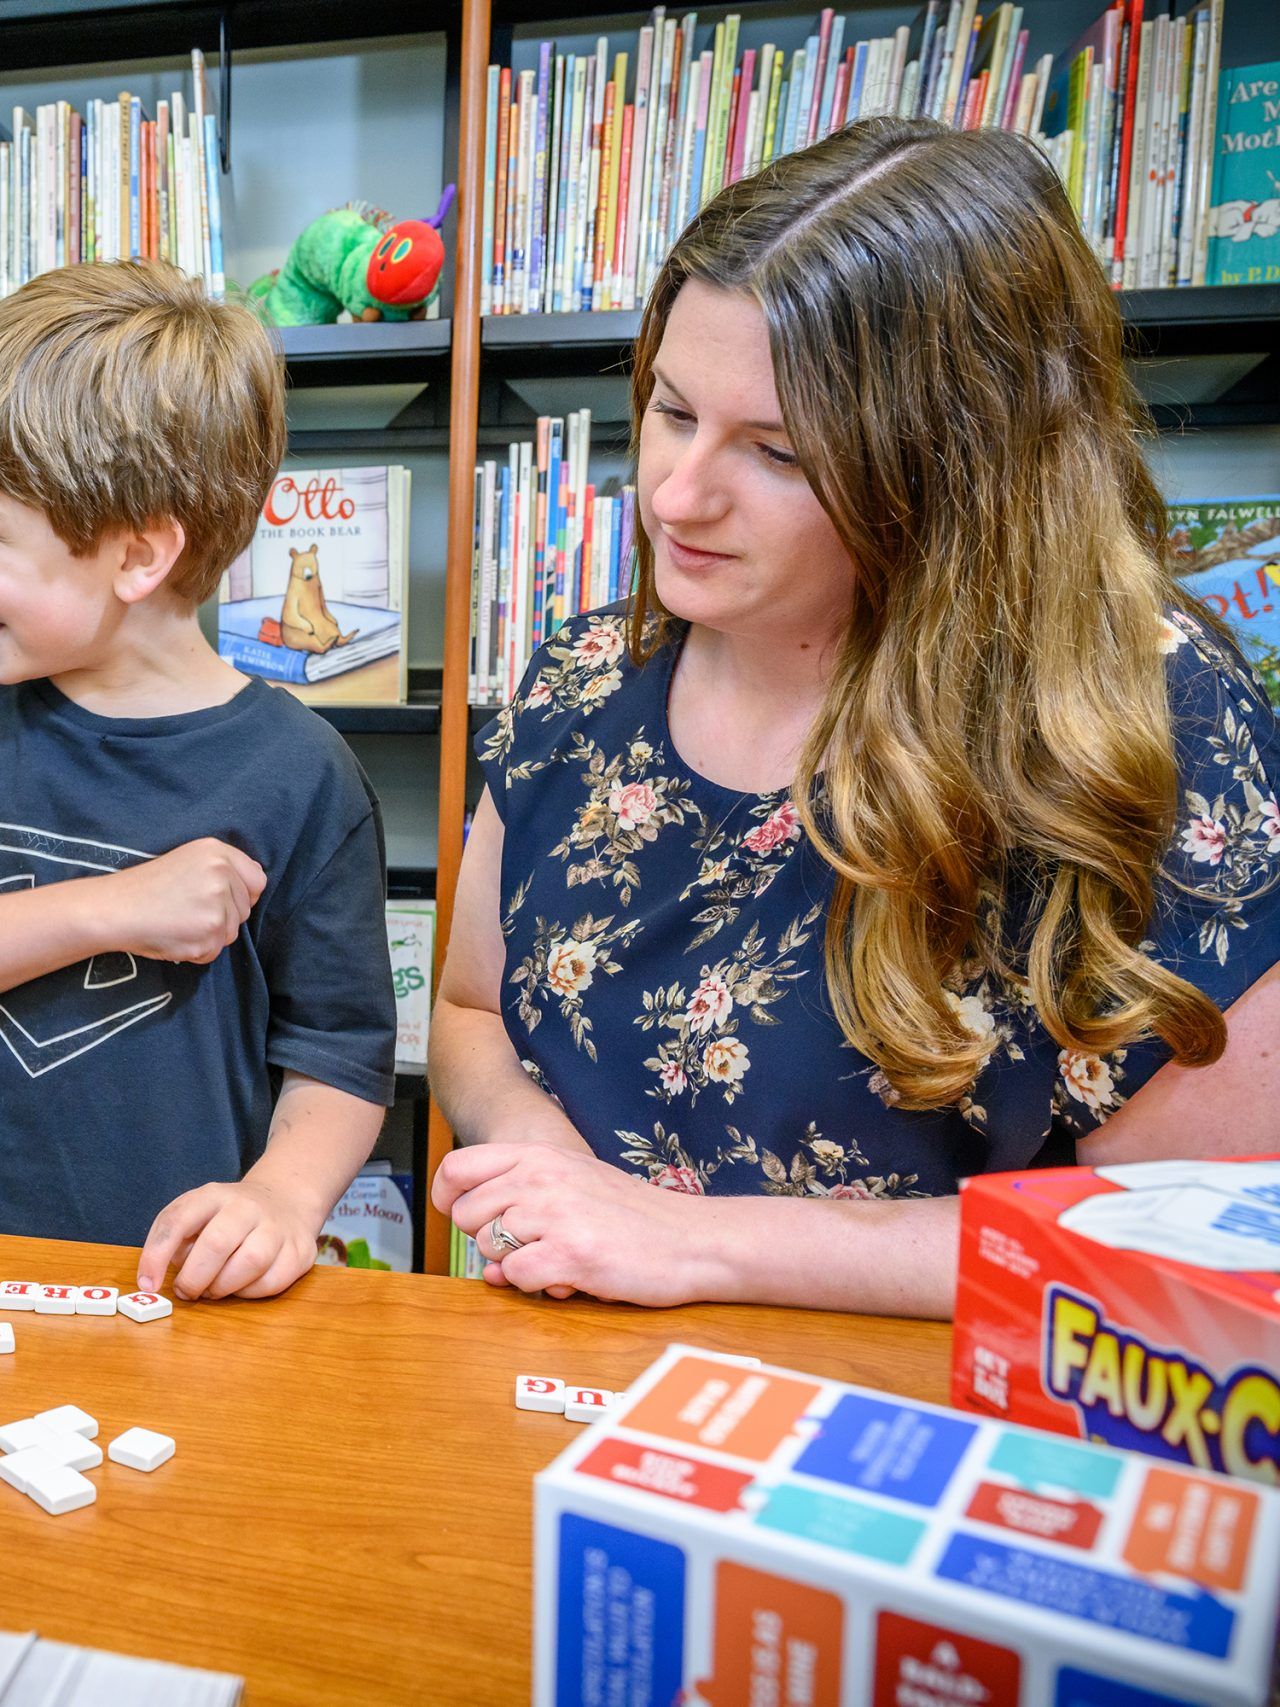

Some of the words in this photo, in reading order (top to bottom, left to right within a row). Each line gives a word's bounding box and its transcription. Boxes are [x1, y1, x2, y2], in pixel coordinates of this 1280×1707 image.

[263, 477, 355, 526] Otto
[260, 528, 285, 539] THE
[290, 527, 325, 538] BOOK
[329, 526, 363, 537] BEAR
[363, 1201, 405, 1224] Moon
